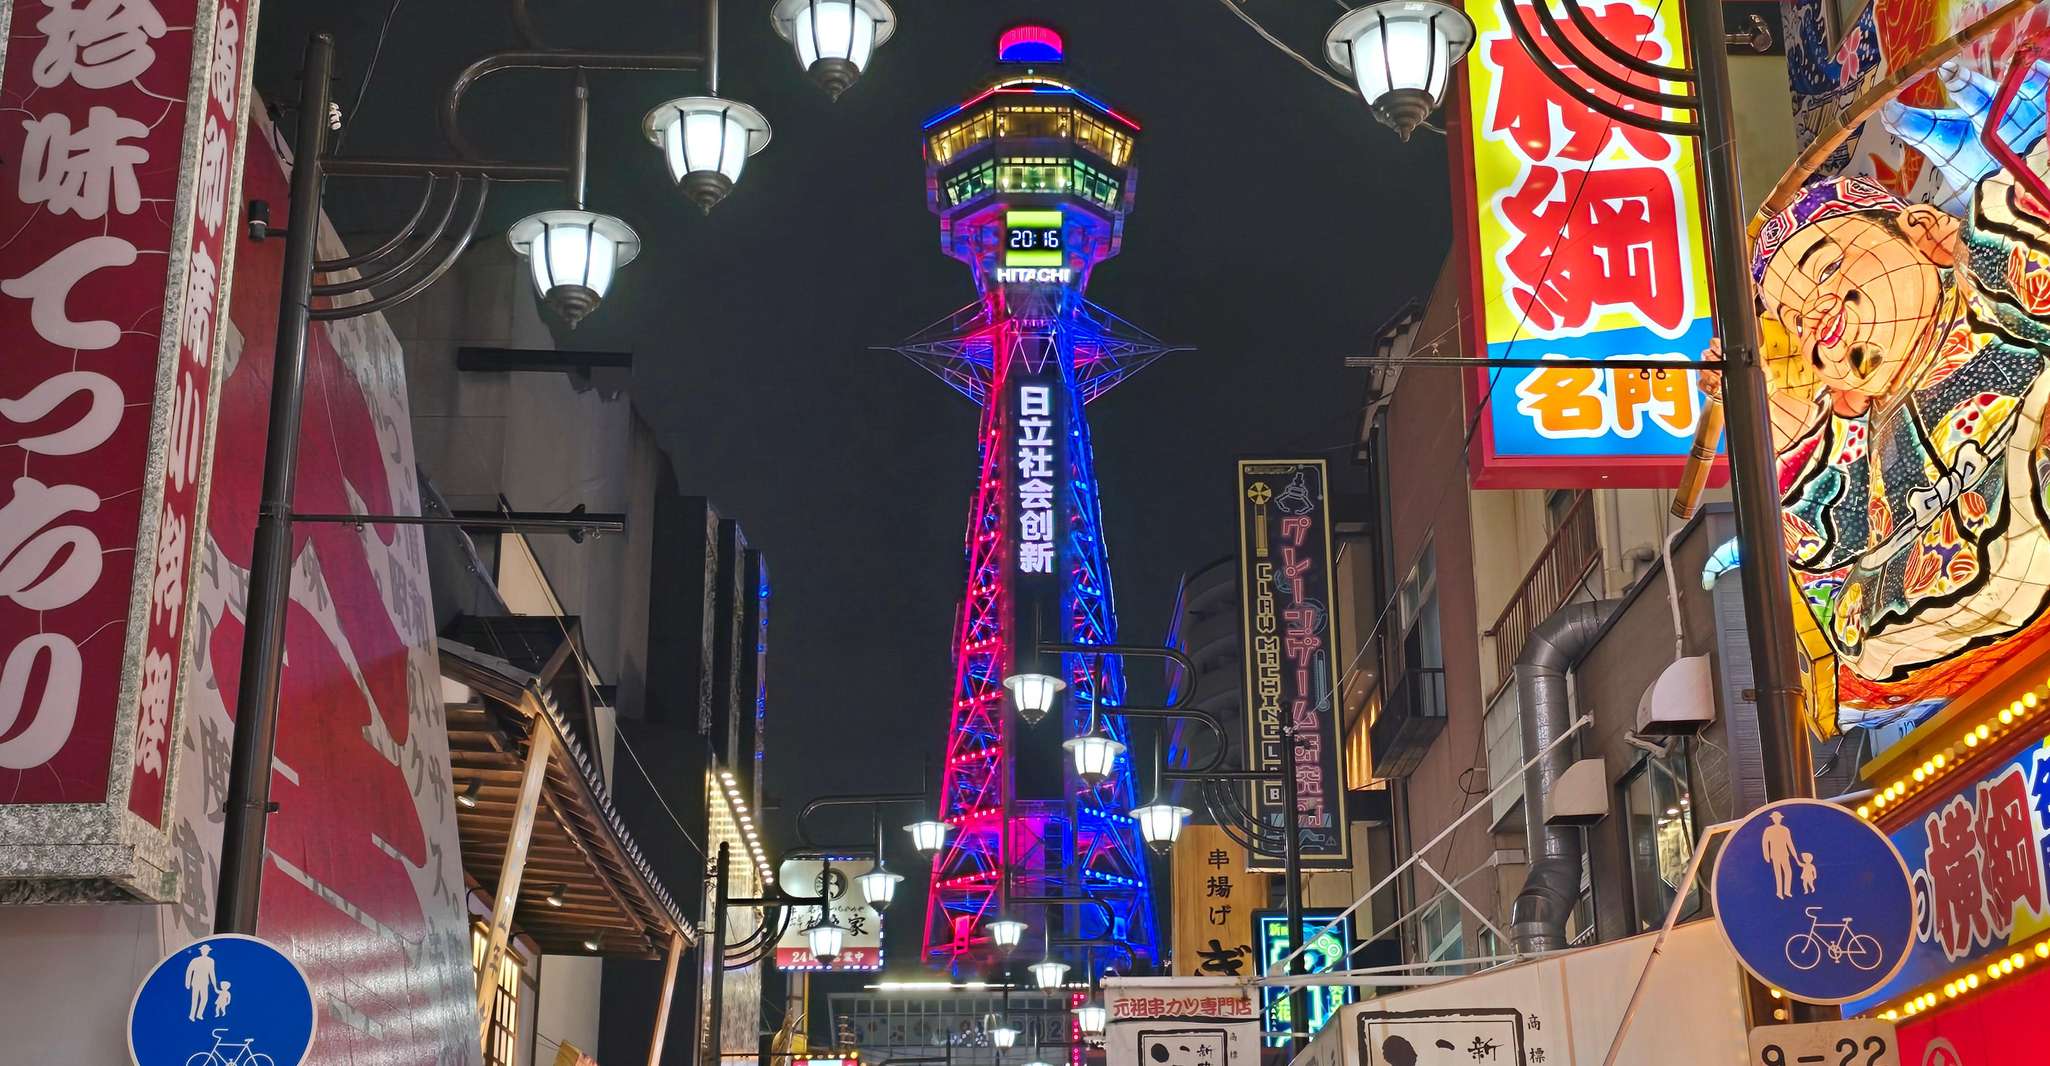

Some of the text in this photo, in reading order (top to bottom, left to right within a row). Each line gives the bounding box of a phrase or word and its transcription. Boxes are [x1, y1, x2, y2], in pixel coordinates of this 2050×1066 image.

[1489, 2, 1687, 331] 横綱
[1010, 230, 1059, 248] 20:16
[997, 268, 1072, 283] HITACHI
[1524, 364, 1692, 432] 名門
[1018, 386, 1055, 574] 日立社会创新
[1256, 563, 1277, 634] CLAW
[1281, 516, 1323, 826] クレーンゲーム研究所
[1265, 743, 1283, 803] LB
[1206, 848, 1233, 926] 串揚げ
[1112, 996, 1252, 1018] 元祖串カツ専門店
[1526, 1014, 1547, 1064] 商標
